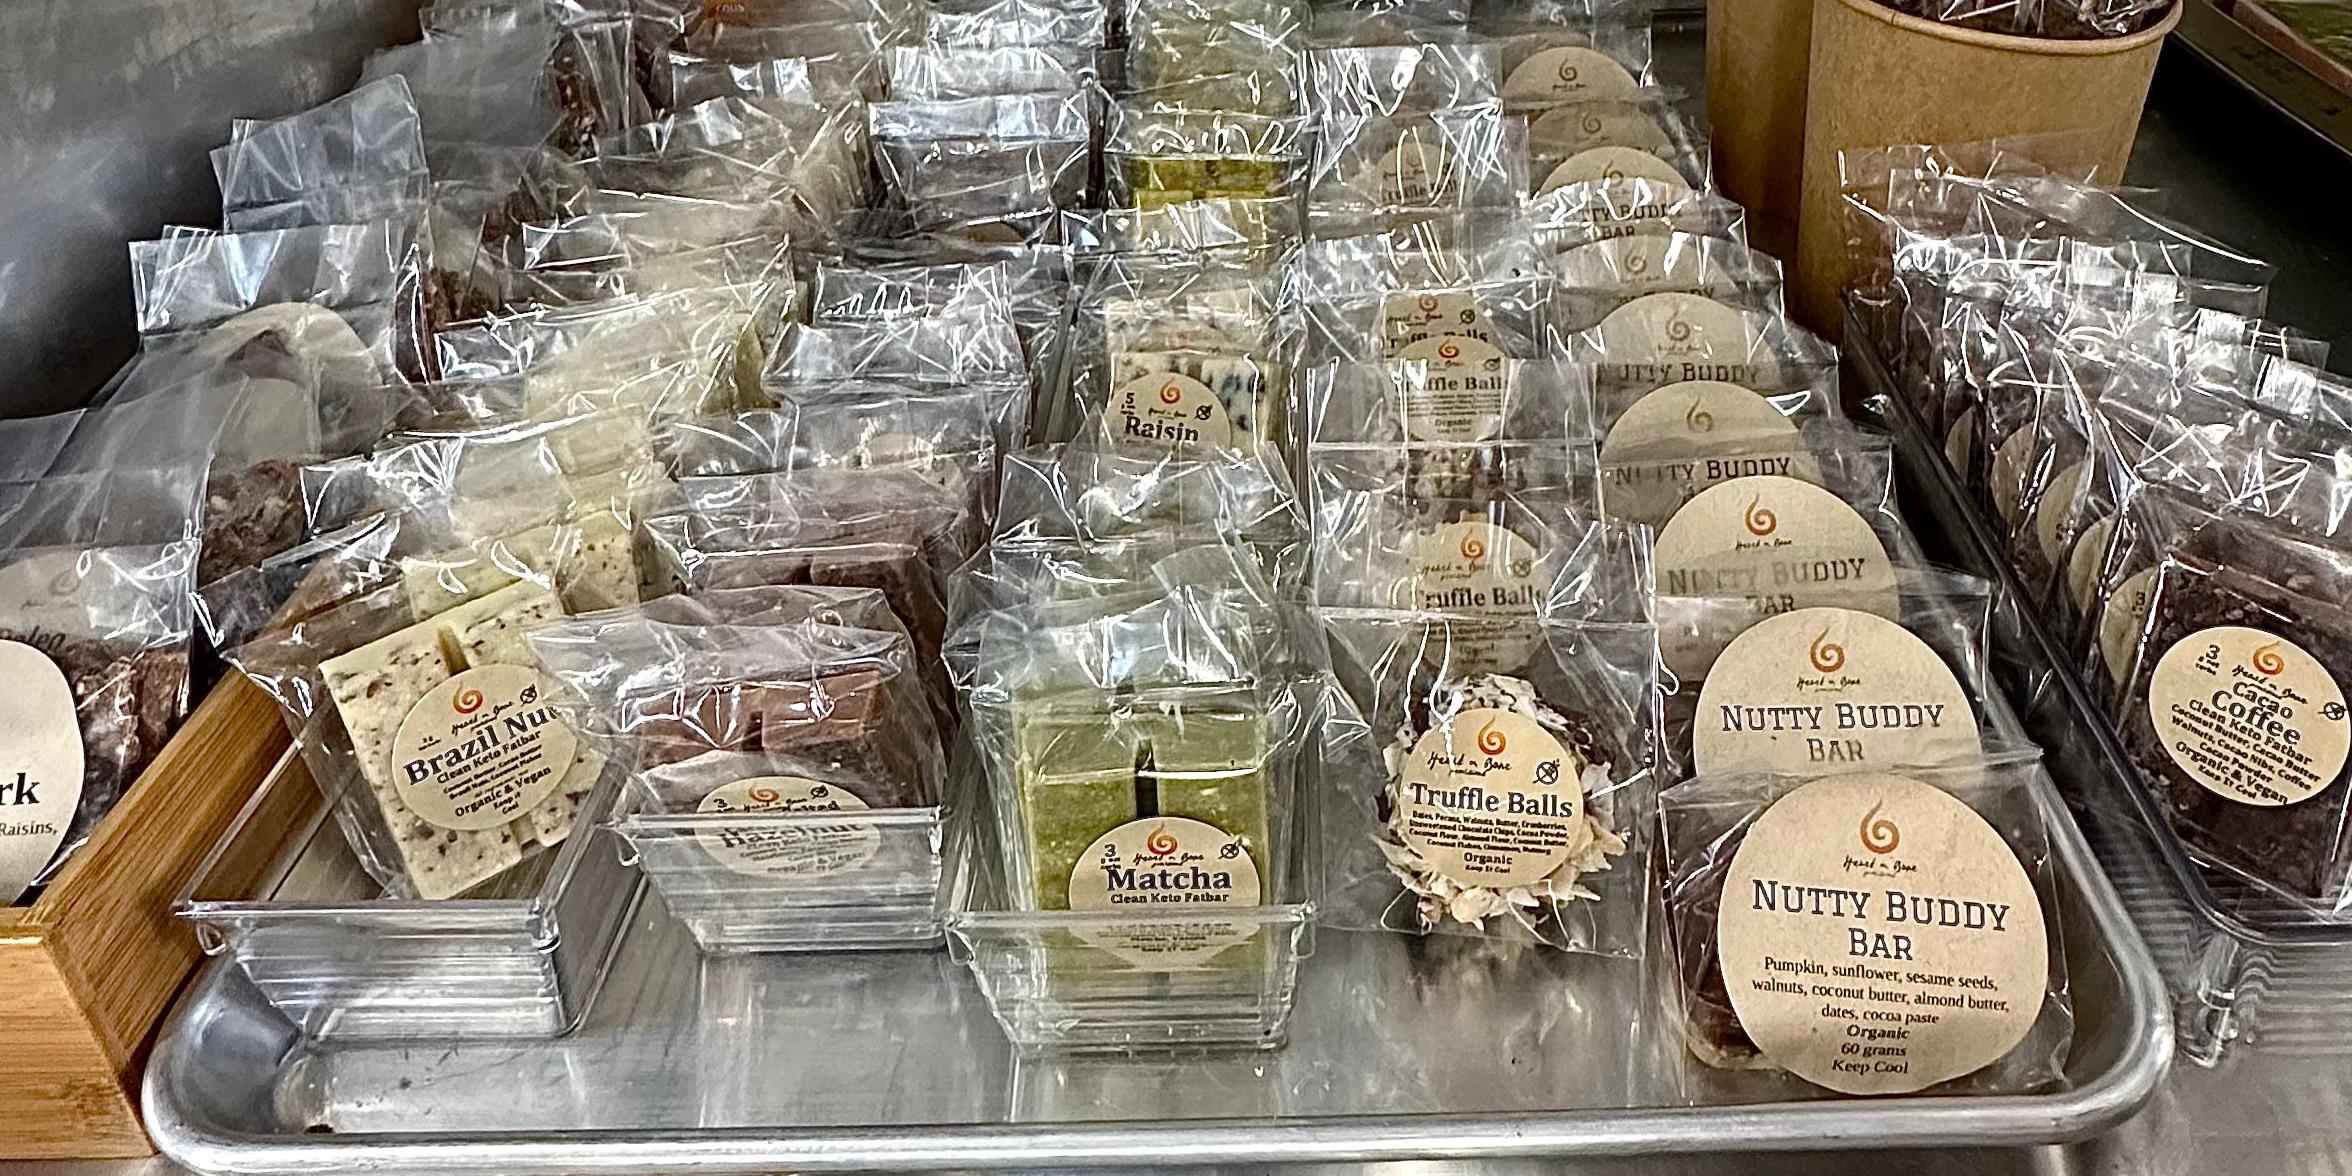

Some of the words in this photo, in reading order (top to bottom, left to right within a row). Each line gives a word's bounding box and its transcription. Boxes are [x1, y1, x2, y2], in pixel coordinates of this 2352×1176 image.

[1123, 415, 1199, 442] Raisin
[1707, 457, 1791, 481] BUDDY
[1772, 558, 1866, 585] BUDDY
[1720, 704, 1823, 732] NUTTY
[1835, 702, 1945, 730] BUDDY
[2232, 681, 2293, 719] Cacao
[2189, 699, 2227, 725] Clean
[2229, 718, 2262, 741] Keto
[2264, 735, 2313, 766] Fatbar
[2211, 690, 2302, 745] Coffee
[403, 724, 501, 786] Brazil
[436, 760, 472, 784] Clean
[473, 749, 500, 768] Keto
[502, 730, 541, 755] Fatbar
[1806, 738, 1865, 763] BAR
[2171, 703, 2214, 729] Coconut
[2214, 724, 2250, 749] Butter,
[2252, 743, 2284, 764] Cacao
[2285, 760, 2322, 783] Butter
[2171, 715, 2215, 745] Walnuts,
[2217, 738, 2249, 760] Cacao
[2250, 754, 2276, 775] Nibs,
[2277, 769, 2312, 791] Coffee
[2175, 741, 2230, 775] Organic
[2230, 769, 2243, 782] &
[2246, 776, 2288, 805] Vegan
[2199, 741, 2230, 763] Cacao
[2231, 758, 2274, 784] Powder
[454, 789, 503, 817] Organic
[504, 784, 514, 794] &
[515, 766, 552, 788] Vegan
[2199, 765, 2221, 782] Keep
[2235, 783, 2257, 799] Cool
[1410, 782, 1499, 812] Truffle
[1507, 791, 1573, 818] Balls
[0, 820, 58, 837] Raisins,
[1104, 843, 1116, 858] 3
[1464, 852, 1513, 865] Organic
[1106, 866, 1233, 892] Matcha
[1110, 892, 1148, 904] Clean
[1150, 892, 1182, 904] Keto
[1184, 892, 1230, 903] Fatbar
[1752, 879, 1871, 919] NUTTY
[1885, 890, 2011, 932] BUDDY
[1848, 927, 1914, 961] BAR
[1764, 956, 1829, 977] Pumpkin,
[1831, 964, 1903, 984] sunflower,
[1905, 972, 1955, 987] sesame
[1957, 975, 1999, 992] seeds,
[1752, 978, 1809, 997] walnuts,
[1812, 982, 1866, 1000] coconut
[1868, 987, 1911, 1006] butter,
[1913, 992, 1965, 1009] almond
[1967, 996, 2011, 1013] butter,
[1821, 1003, 1859, 1022] dates,
[1863, 1008, 1902, 1023] cocoa
[1904, 1011, 1940, 1027] paste
[1846, 1024, 1911, 1042] Organic
[1832, 1059, 1871, 1076] Keep
[1874, 1060, 1909, 1075] Cool
[1841, 1042, 1860, 1056] 60
[1862, 1043, 1907, 1059] grams
